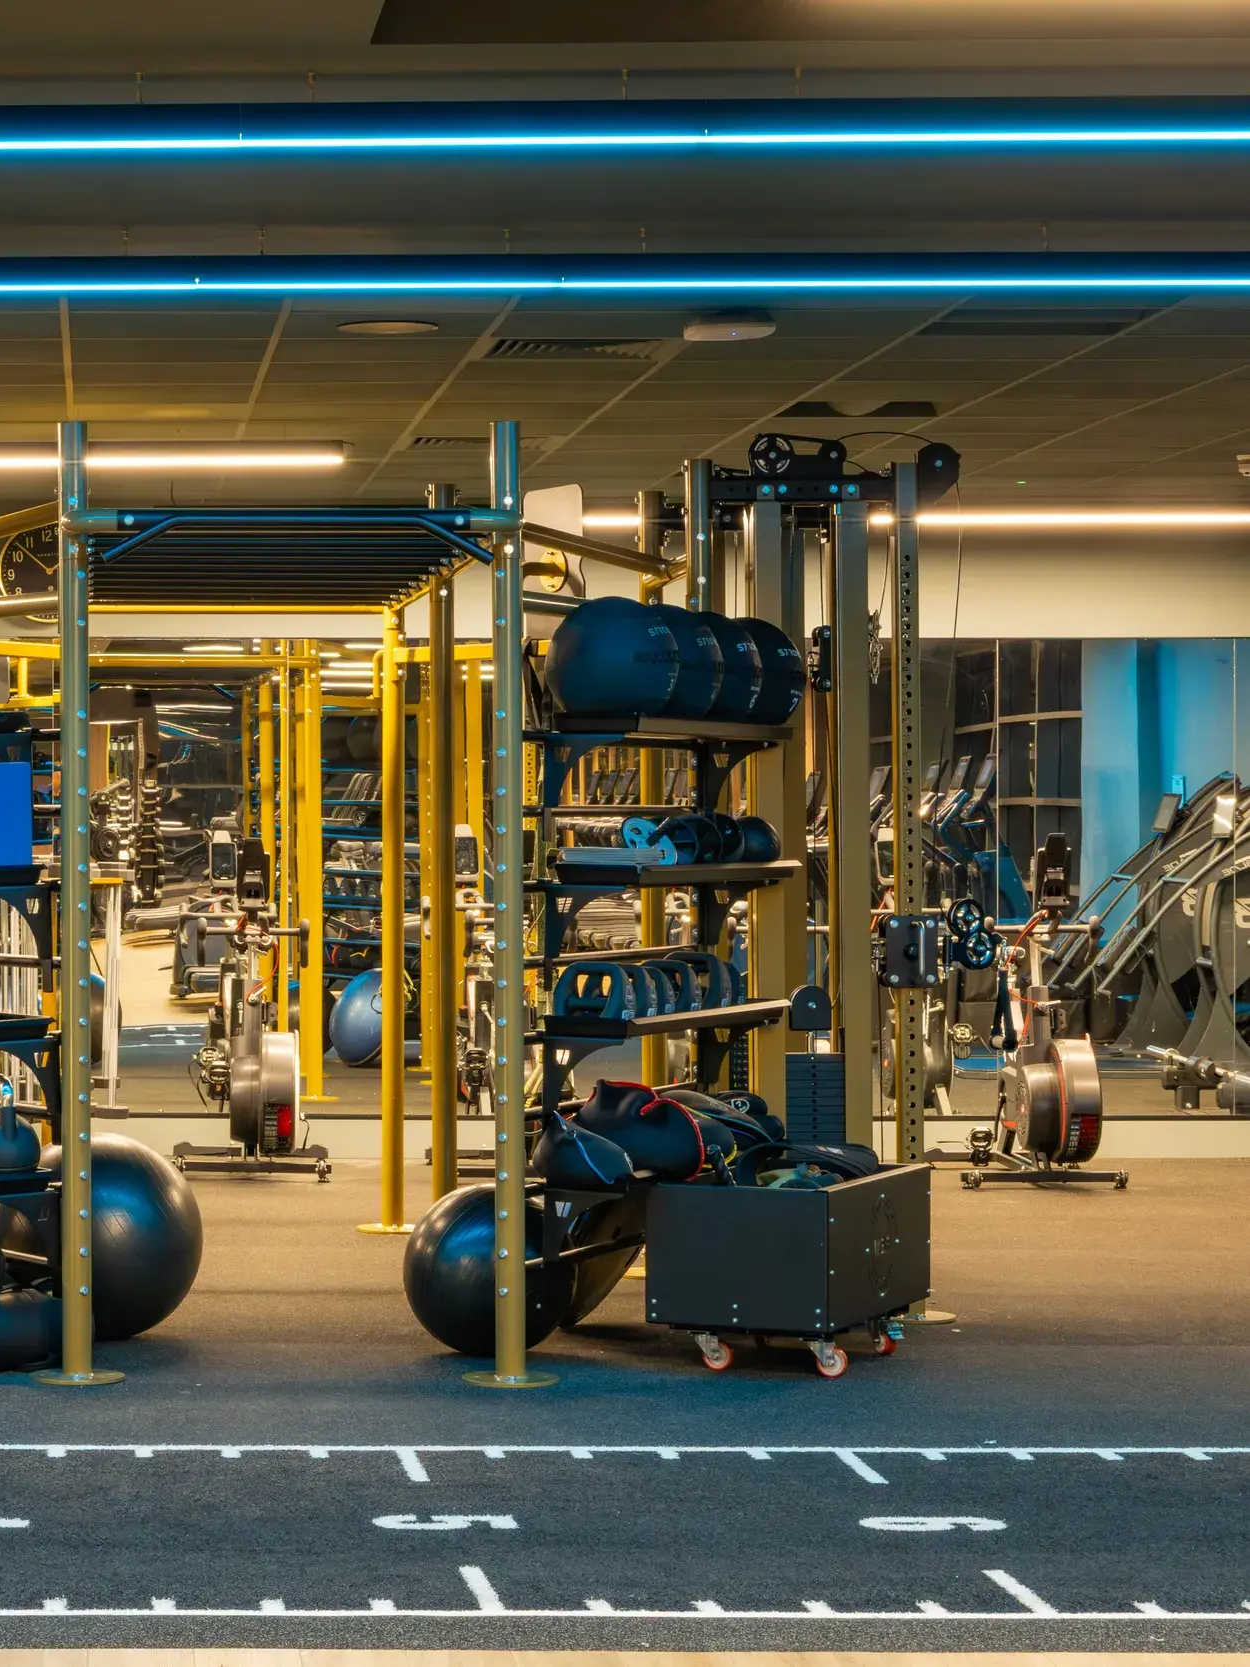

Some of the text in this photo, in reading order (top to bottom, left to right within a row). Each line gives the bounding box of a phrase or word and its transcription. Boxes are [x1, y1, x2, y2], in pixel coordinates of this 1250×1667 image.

[25, 536, 34, 549] 11
[41, 529, 53, 542] 12
[12, 548, 24, 563] 10
[7, 568, 16, 581] 9
[788, 697, 799, 712] 7
[371, 1513, 520, 1531] 5
[858, 1515, 1008, 1532] 6
